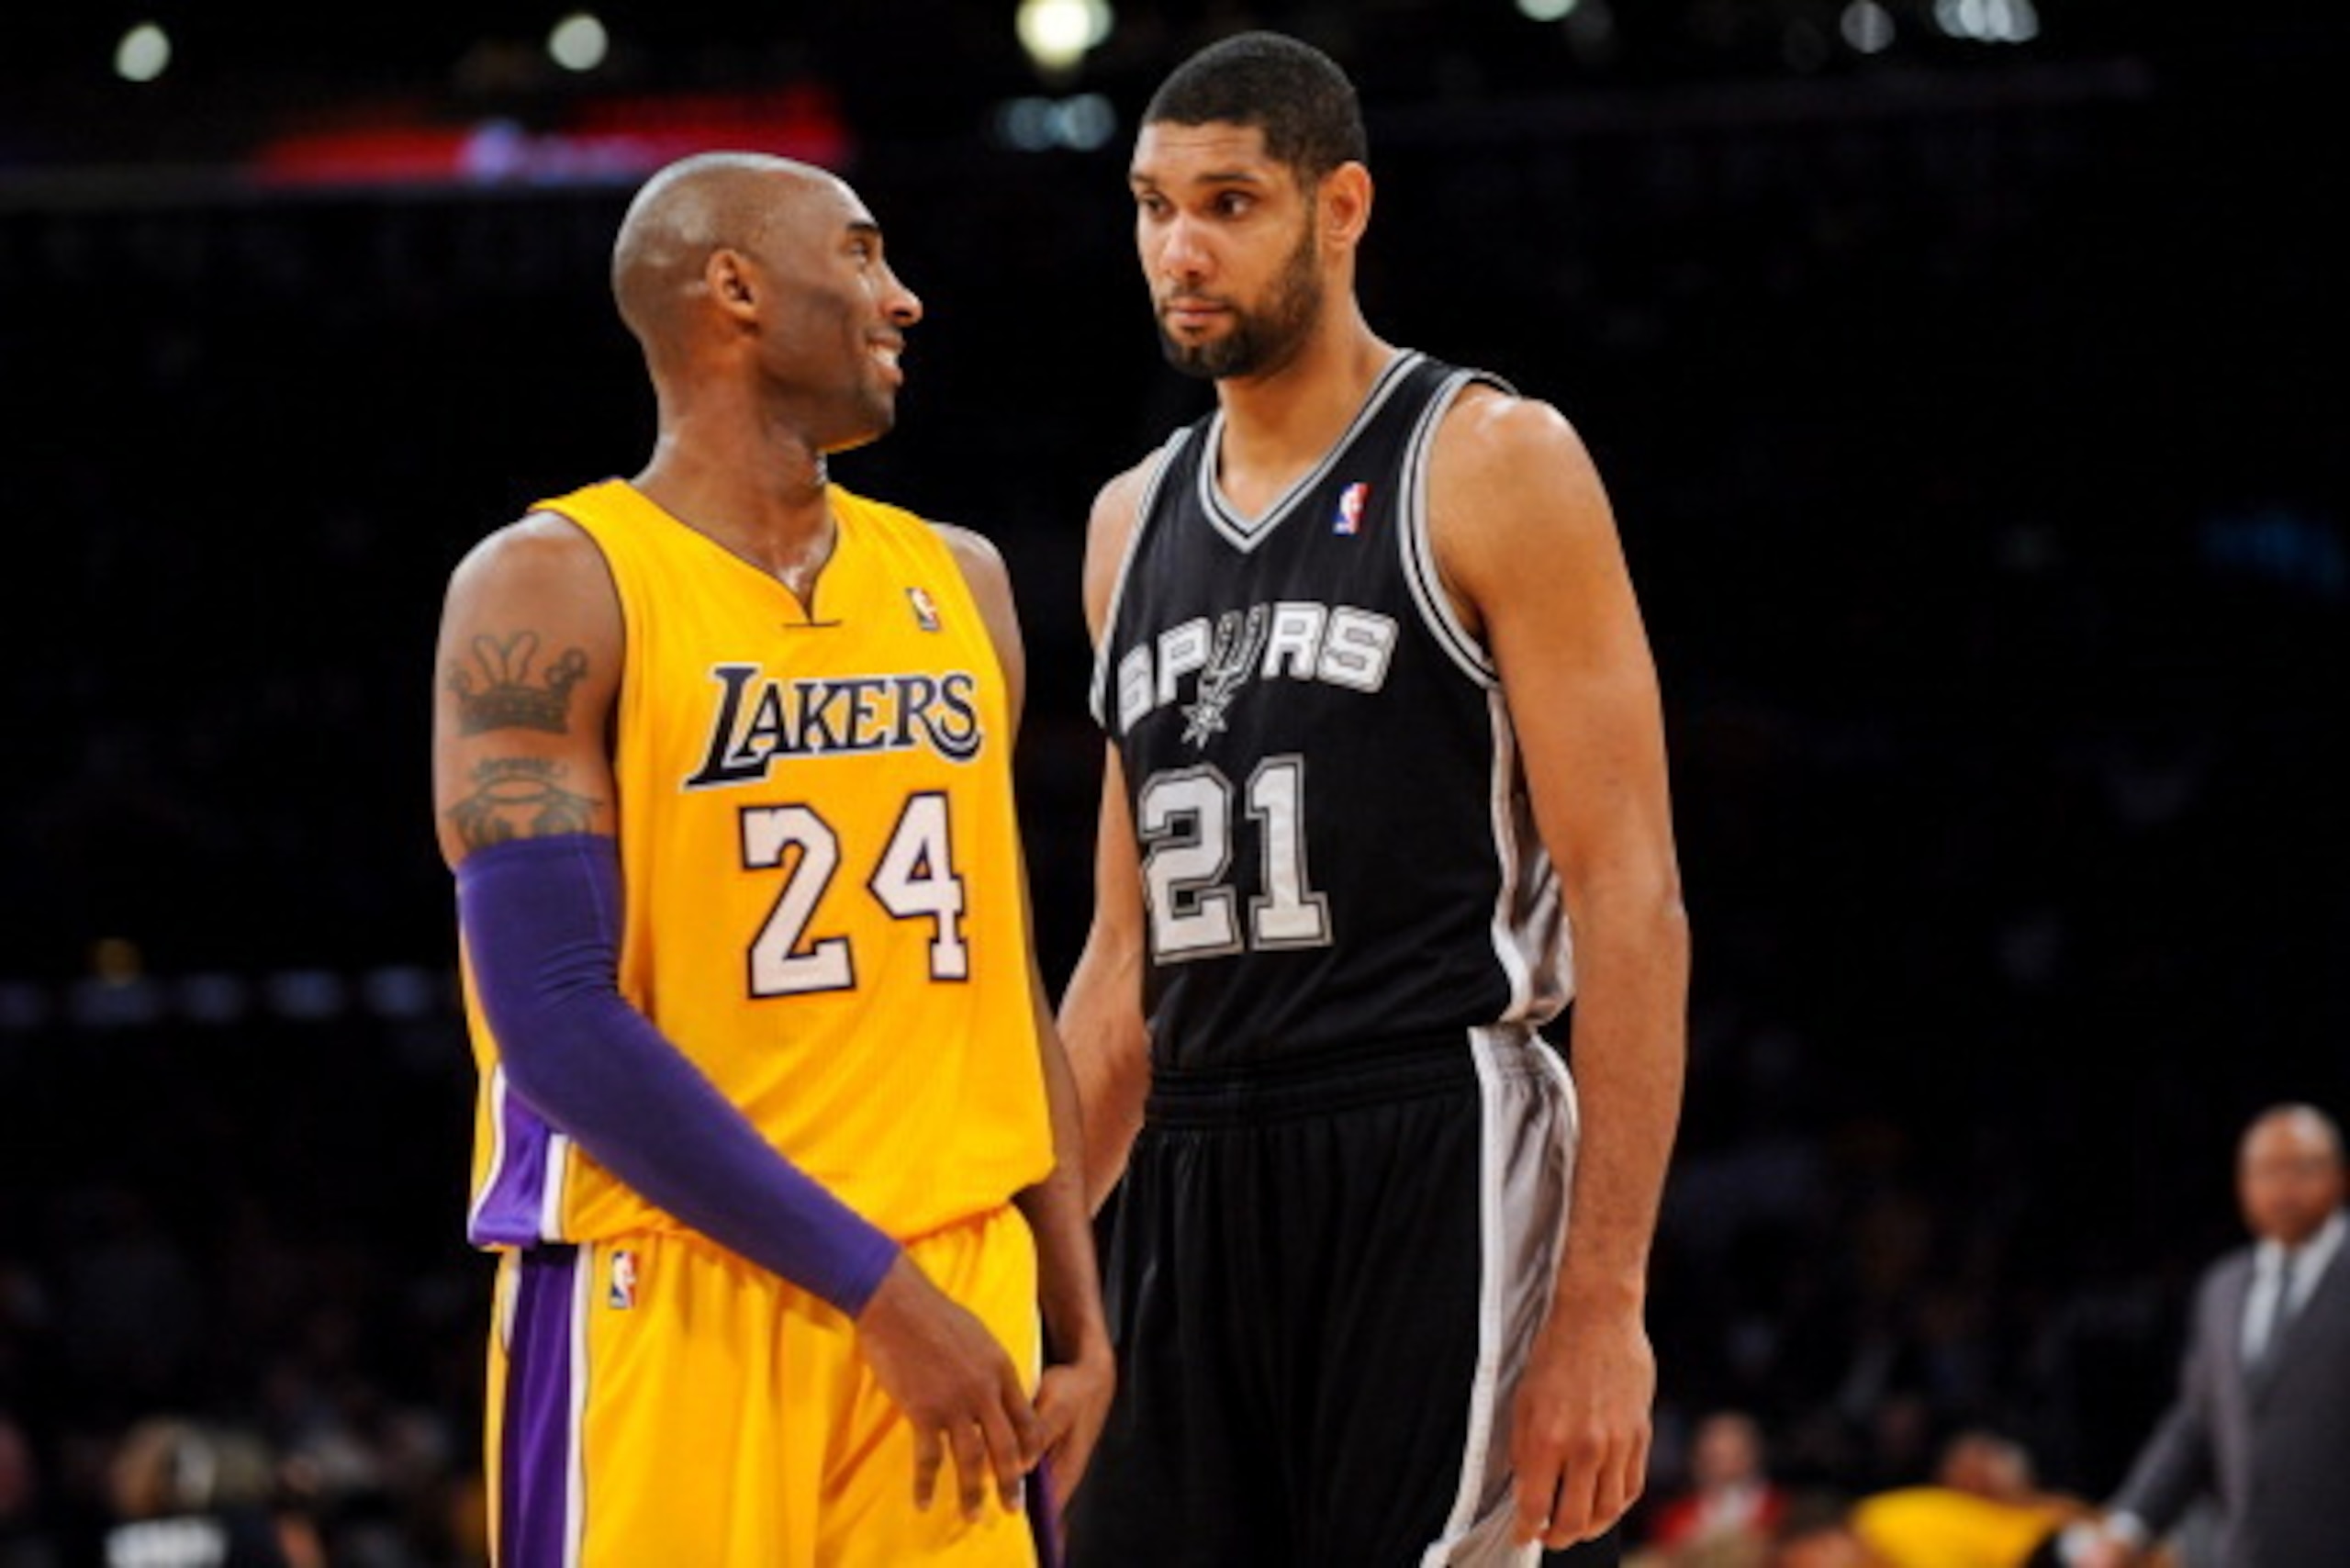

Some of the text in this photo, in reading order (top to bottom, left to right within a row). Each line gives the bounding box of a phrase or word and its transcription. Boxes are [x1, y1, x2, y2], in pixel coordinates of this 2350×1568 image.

[681, 661, 983, 791] LAKERS
[1117, 602, 1398, 748] SPURS
[738, 790, 970, 1001] 24
[1138, 754, 1333, 965] 21
